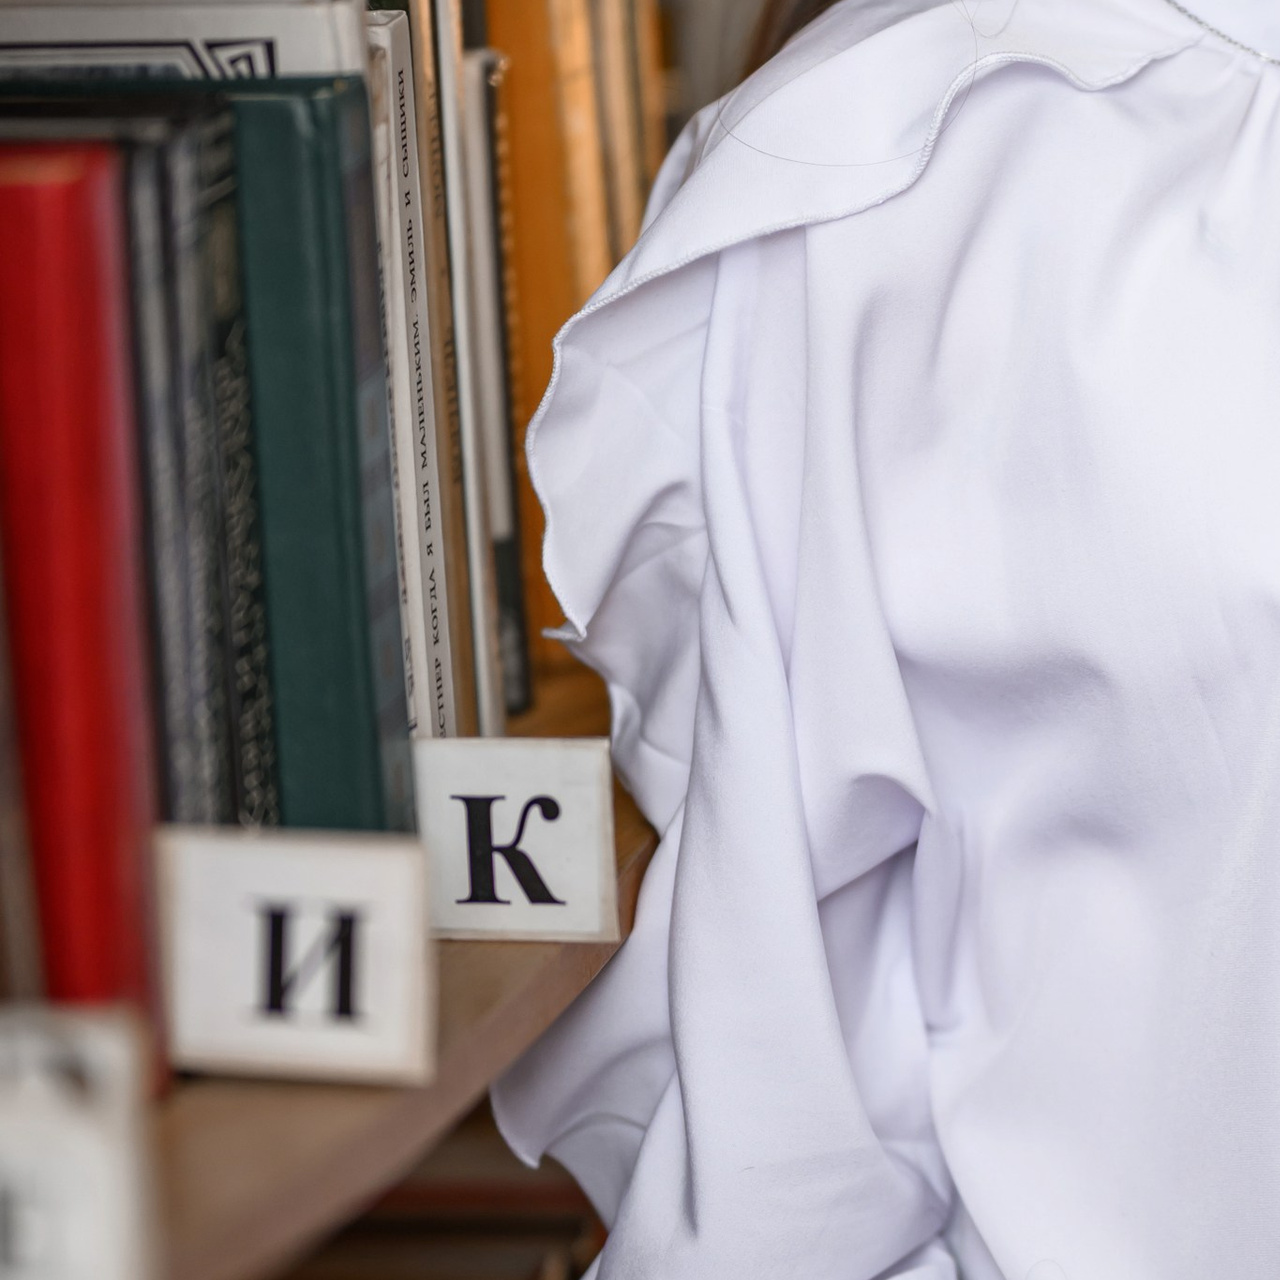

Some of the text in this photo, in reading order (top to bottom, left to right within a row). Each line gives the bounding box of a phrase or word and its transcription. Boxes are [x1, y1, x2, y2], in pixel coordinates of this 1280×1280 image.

[398, 70, 410, 178] СЫЩИКИ
[404, 190, 412, 207] И
[407, 218, 417, 303] ЭМИЛЬ
[422, 480, 432, 532] БЫЛ
[426, 542, 433, 557] Я
[428, 566, 440, 646] КОГДА
[450, 795, 567, 905] К
[252, 898, 370, 1022] И
